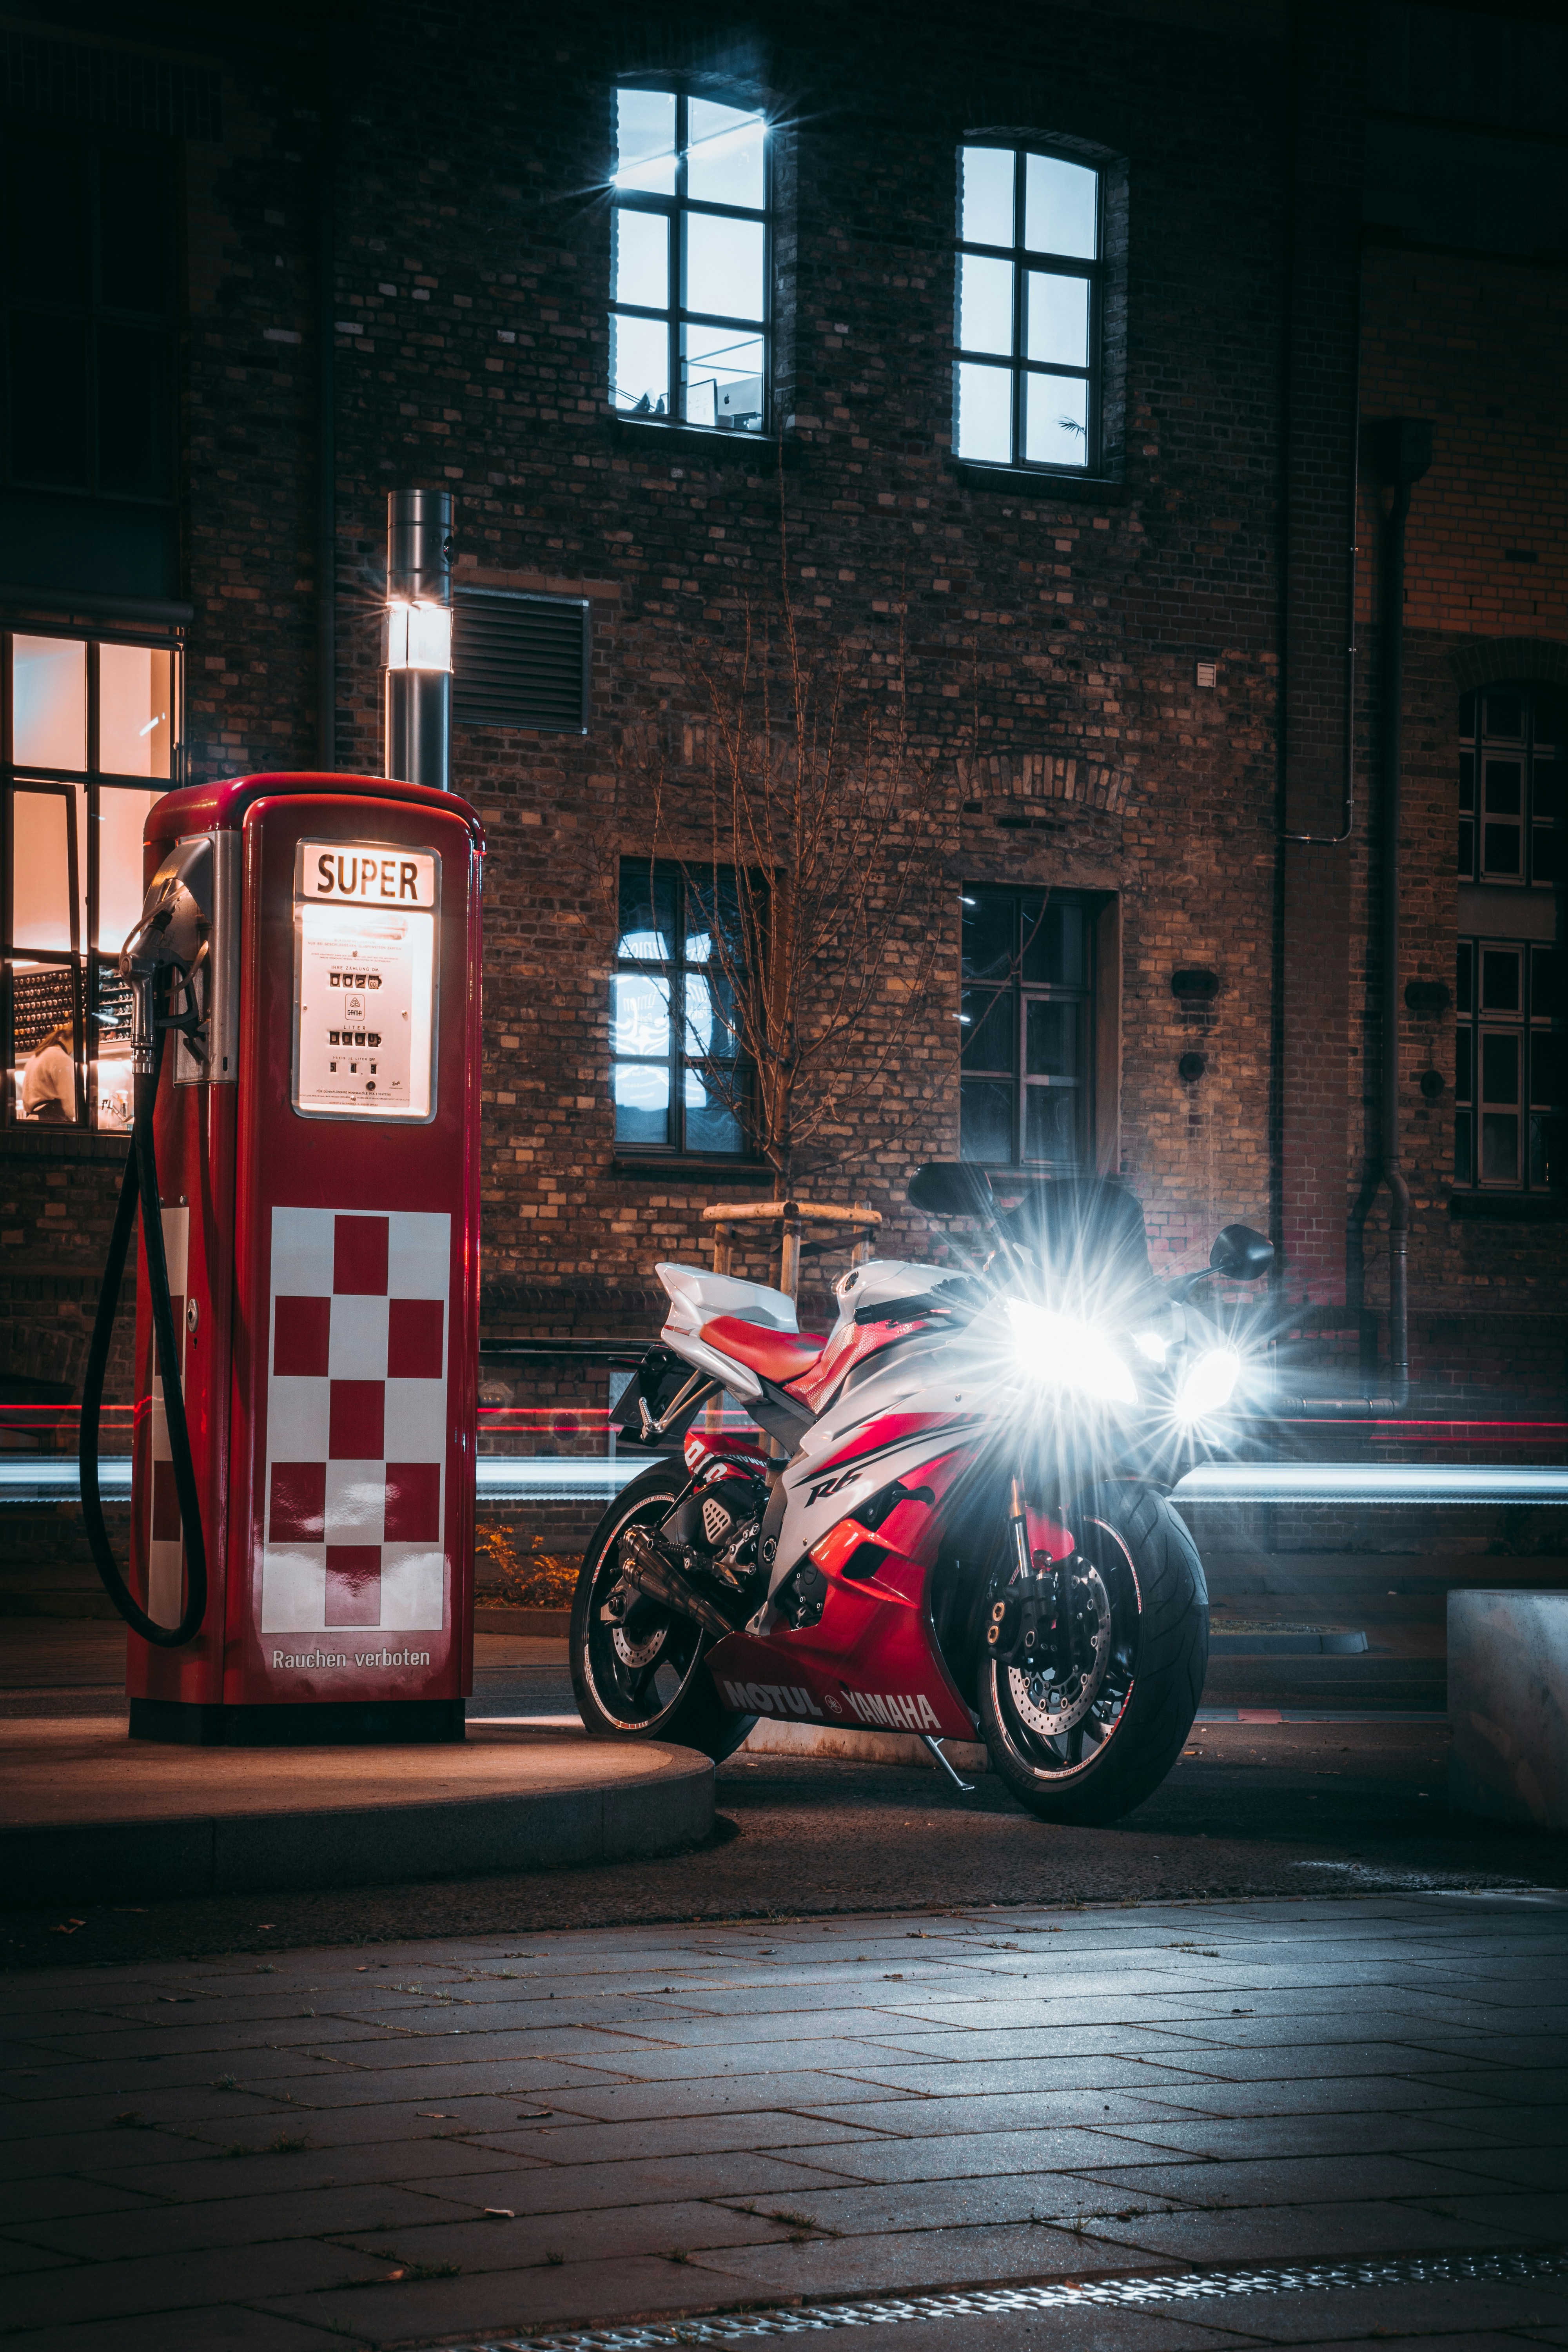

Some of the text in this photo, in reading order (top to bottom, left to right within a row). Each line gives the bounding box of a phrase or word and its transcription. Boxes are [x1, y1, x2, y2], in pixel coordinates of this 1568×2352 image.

[317, 854, 419, 900] SUPER
[724, 1454, 767, 1468] AMAH
[804, 1470, 863, 1508] R6
[629, 1498, 652, 1514] YAMAHA
[1115, 1534, 1142, 1611] YAMAHA RACING
[272, 1648, 430, 1669] Rauchen verboten
[591, 1684, 606, 1713] YAMAHA
[723, 1681, 824, 1716] MOTUL
[840, 1690, 942, 1729] YAMAHA
[1063, 1758, 1091, 1776] YAMAHA
